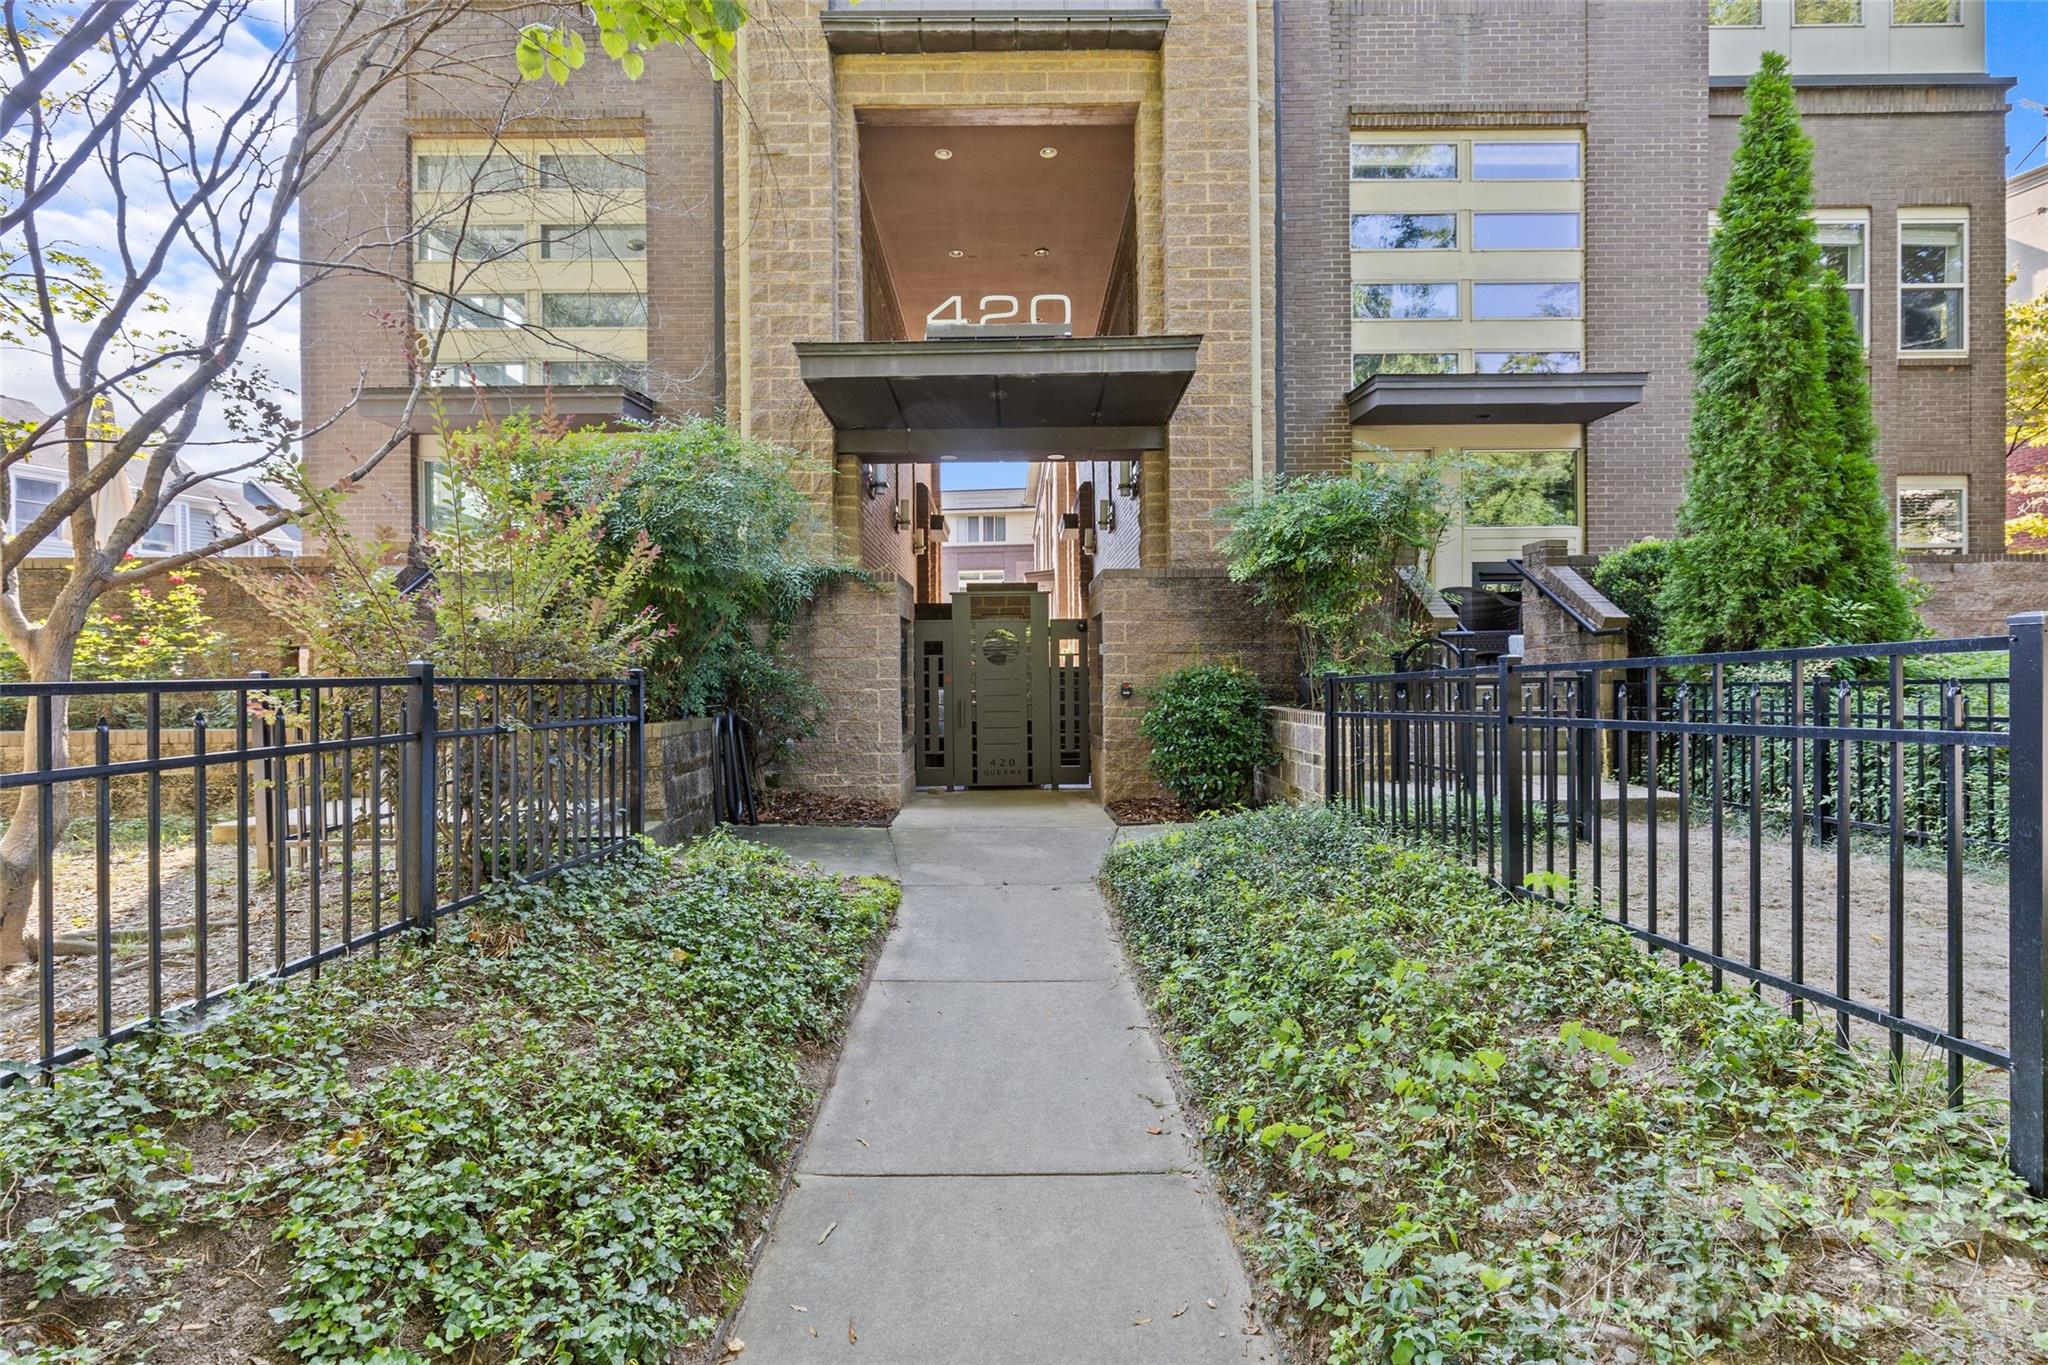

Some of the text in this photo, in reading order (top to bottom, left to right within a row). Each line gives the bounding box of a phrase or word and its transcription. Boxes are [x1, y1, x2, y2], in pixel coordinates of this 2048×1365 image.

[926, 294, 1072, 325] 420
[990, 758, 1016, 767] 420
[983, 769, 1022, 777] QUEENS
